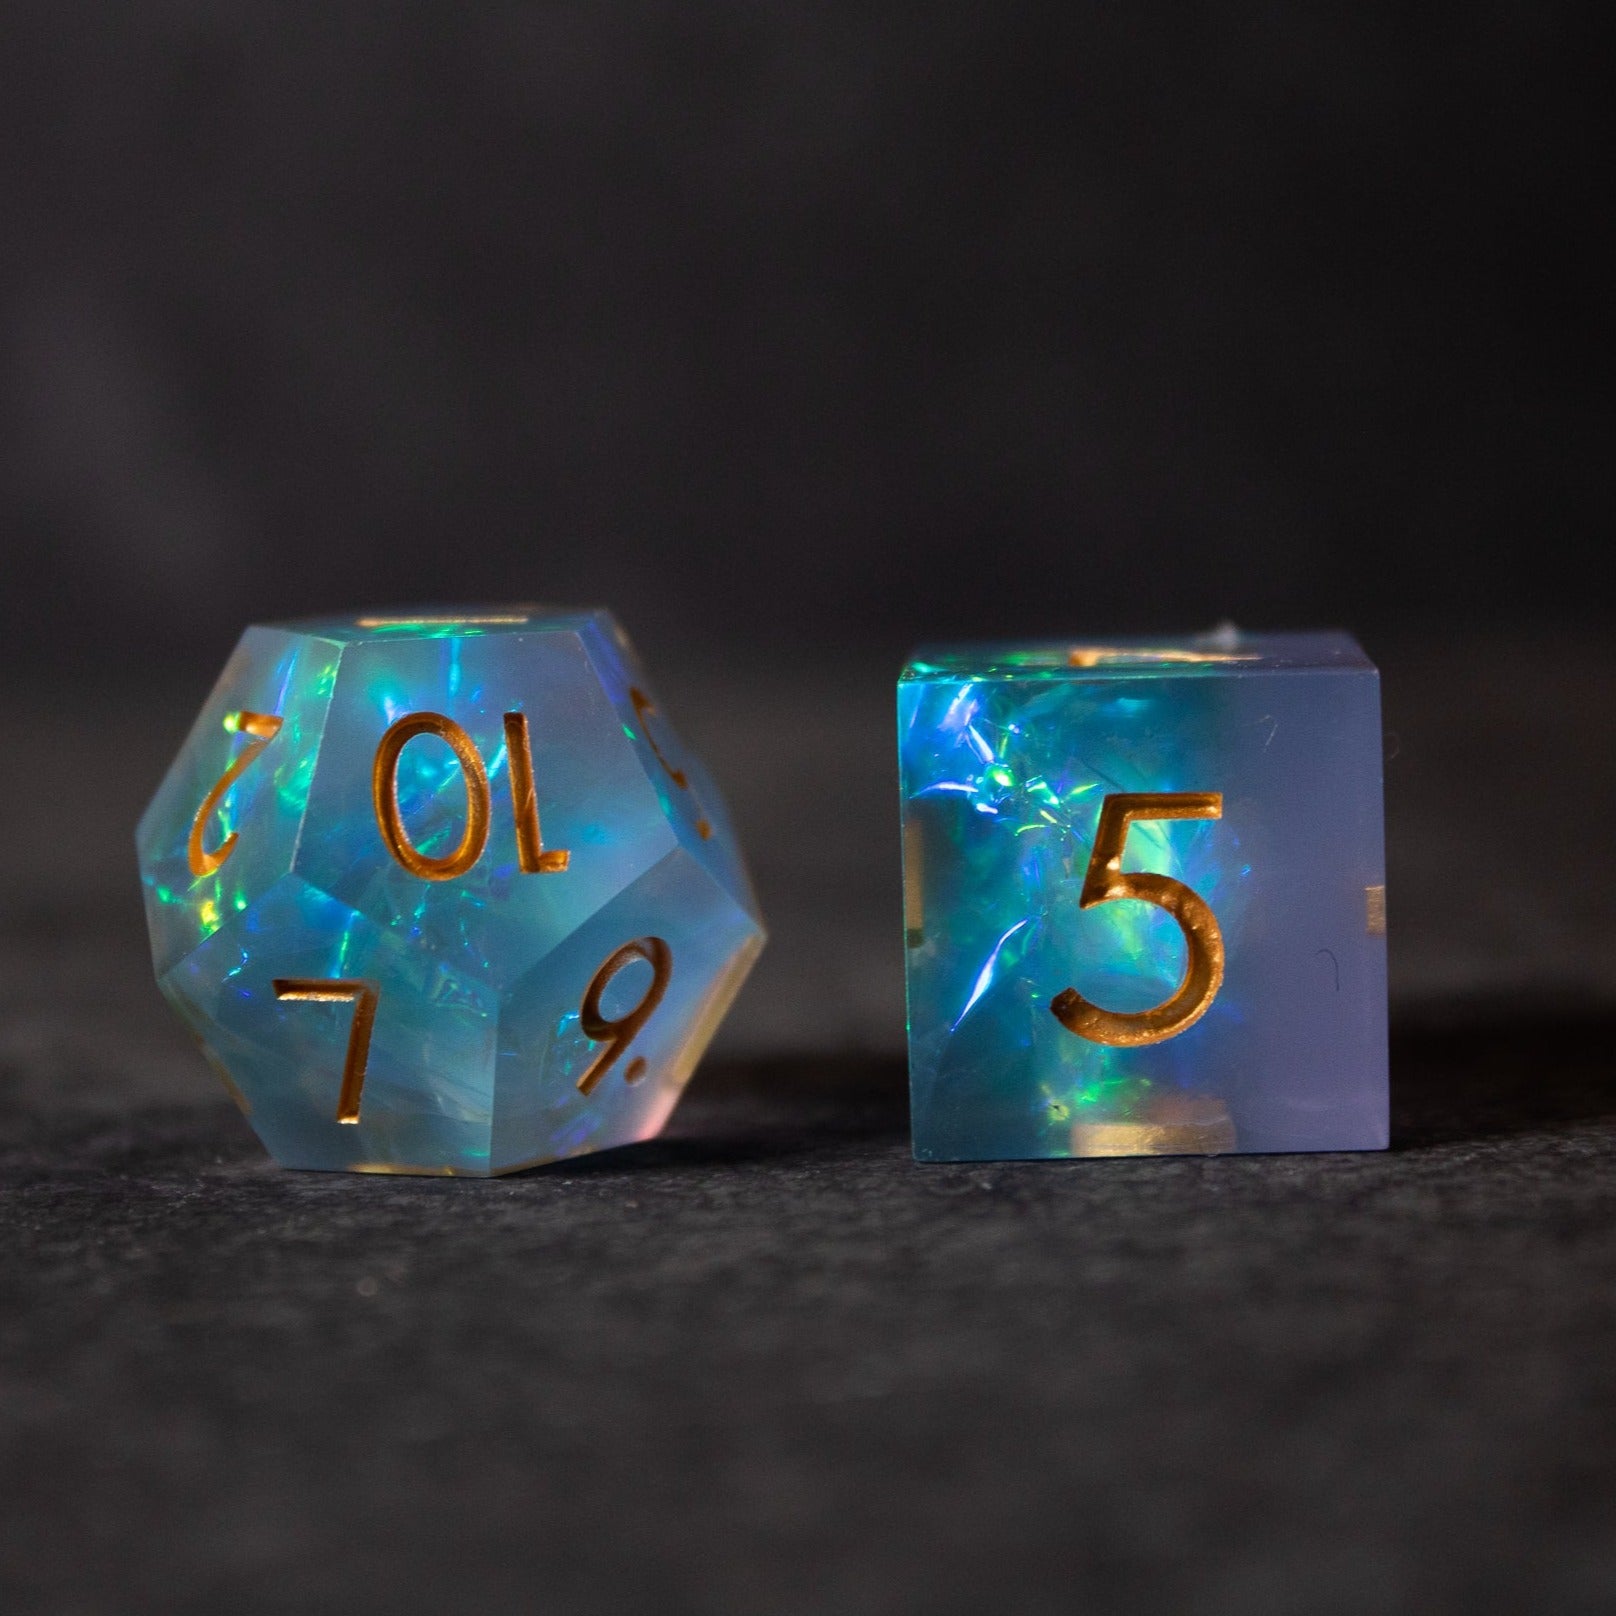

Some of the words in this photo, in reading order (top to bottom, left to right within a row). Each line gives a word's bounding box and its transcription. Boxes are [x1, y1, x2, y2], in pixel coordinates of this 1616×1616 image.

[188, 710, 285, 877] 2
[372, 711, 571, 882] 10
[1049, 791, 1226, 1048] 5
[272, 978, 380, 1125] 7
